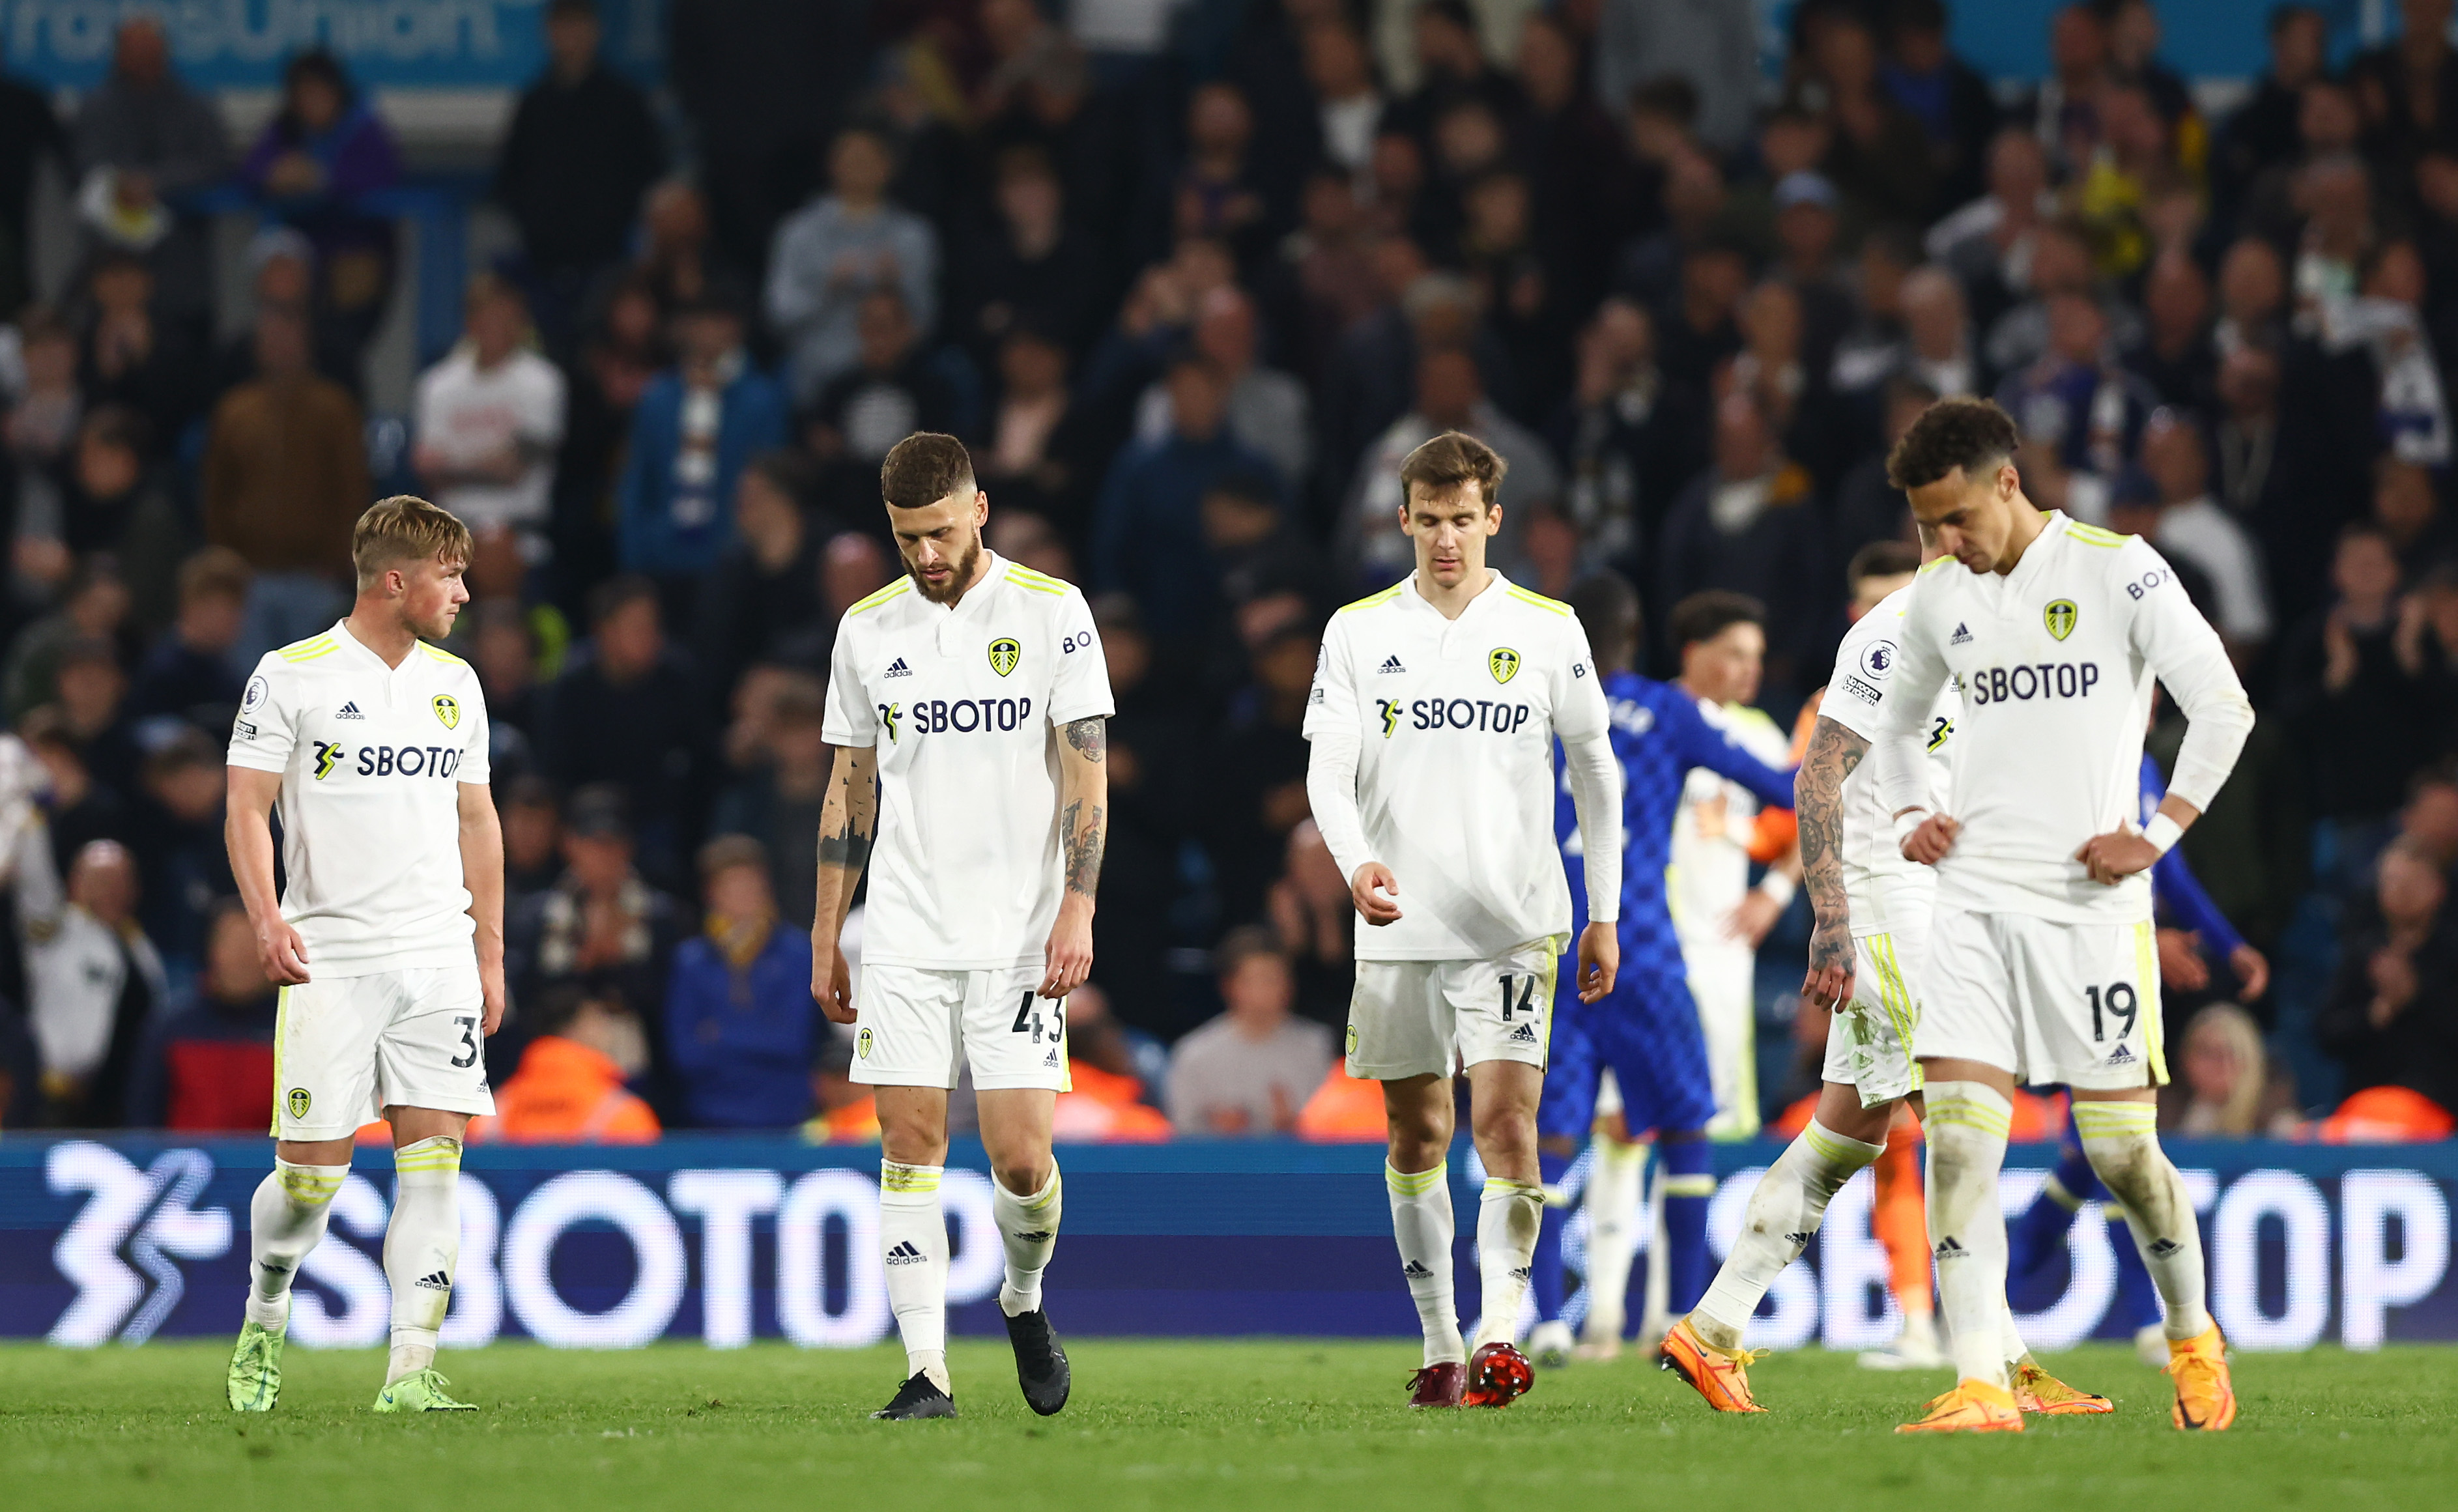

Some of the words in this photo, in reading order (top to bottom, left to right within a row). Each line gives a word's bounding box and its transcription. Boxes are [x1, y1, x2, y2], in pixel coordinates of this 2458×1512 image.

[883, 669, 913, 679] adidas
[1377, 665, 1406, 674] adidas
[1845, 675, 1857, 686] No
[1855, 681, 1879, 699] room
[1974, 662, 2098, 706] SBOTOP
[336, 711, 365, 720] adidas
[913, 697, 1031, 734] SBOTOP
[1412, 697, 1529, 734] SBOTOP
[1012, 991, 1063, 1044] 43
[1498, 974, 1544, 1024] 14
[2086, 982, 2137, 1042] 19
[451, 1016, 486, 1070] 3
[1510, 1033, 1537, 1044] adidas
[886, 1255, 928, 1265] adidas
[1706, 1167, 2452, 1352] SBOOP
